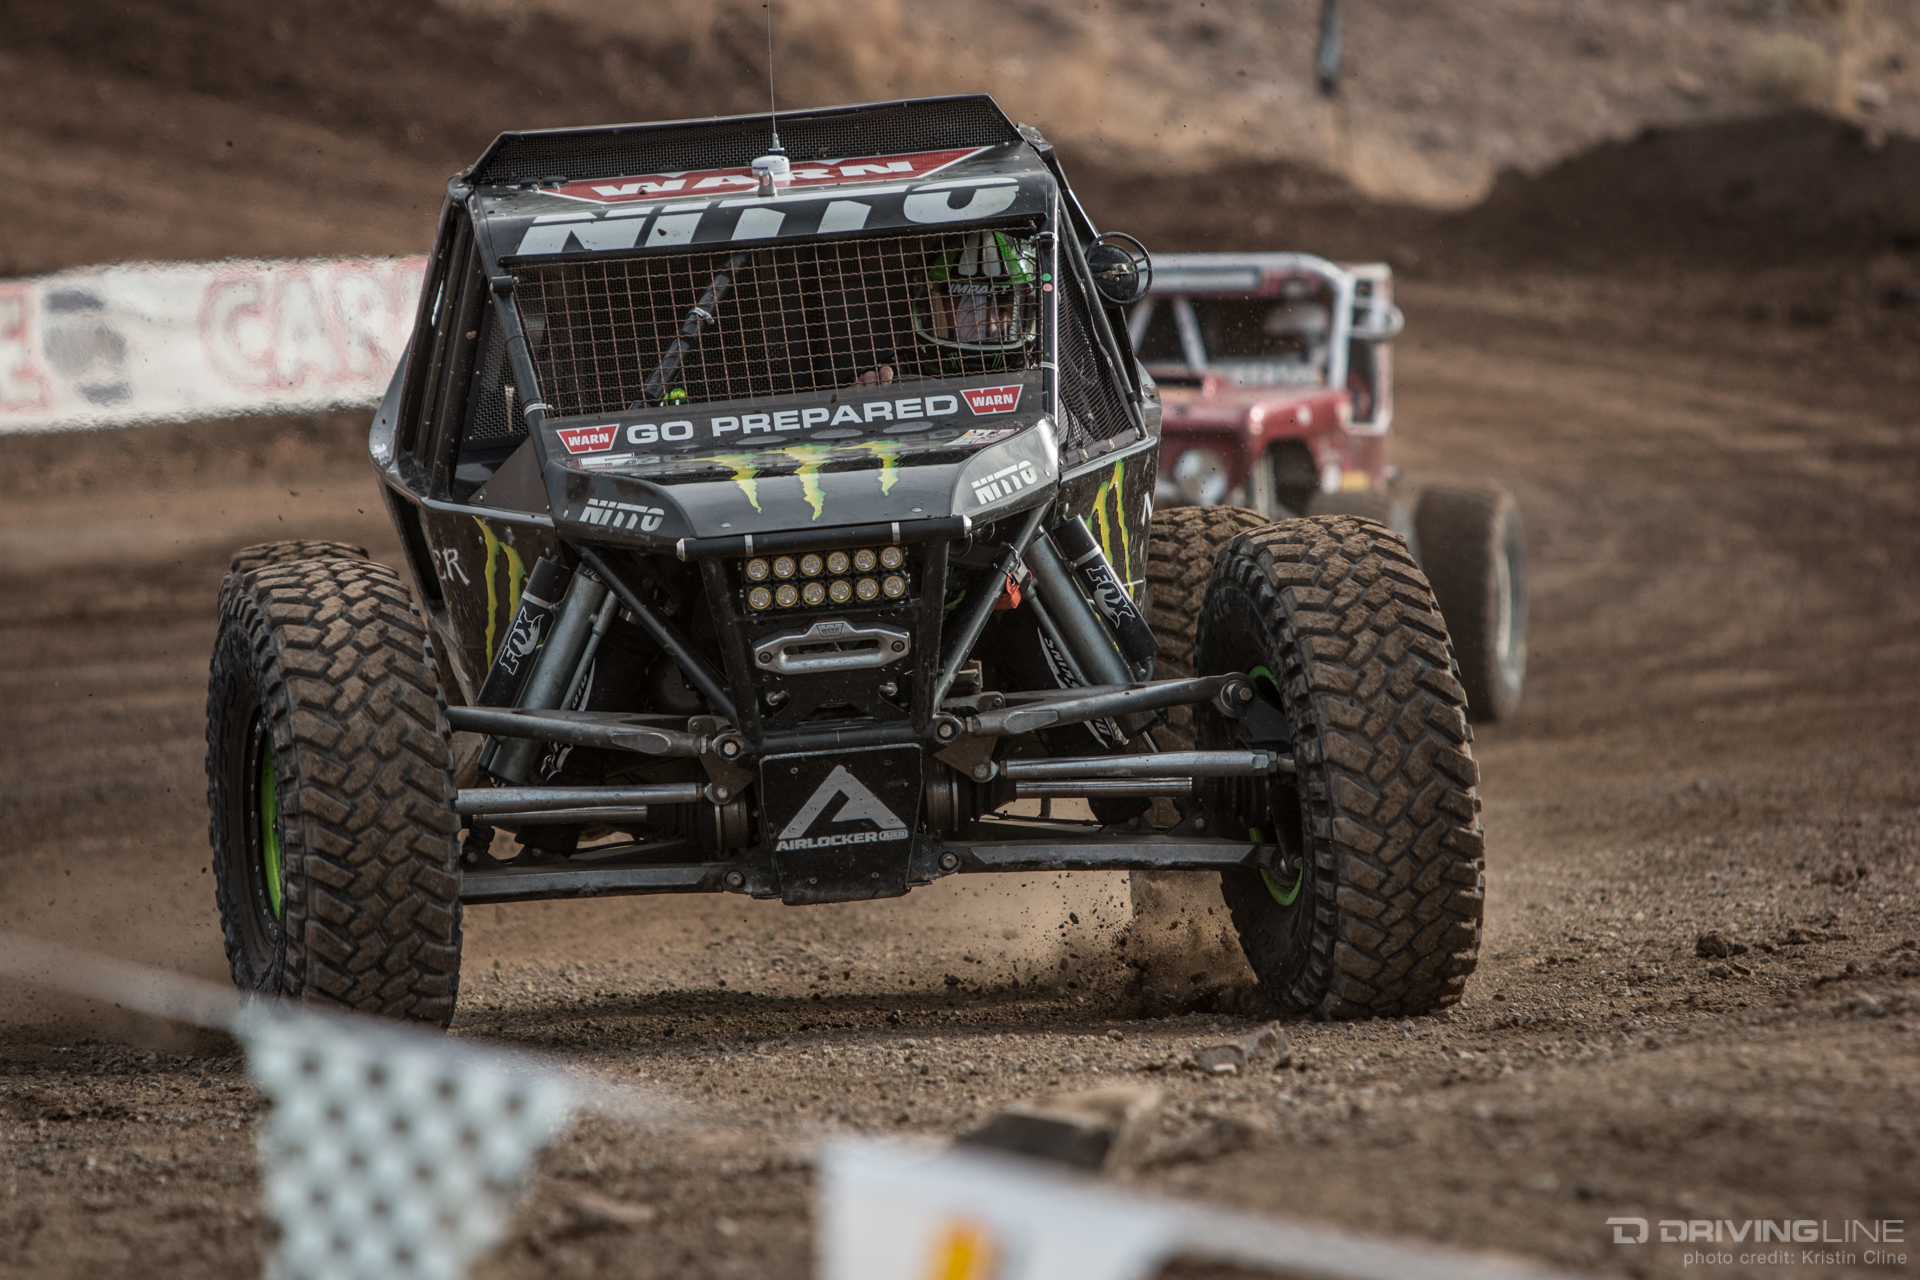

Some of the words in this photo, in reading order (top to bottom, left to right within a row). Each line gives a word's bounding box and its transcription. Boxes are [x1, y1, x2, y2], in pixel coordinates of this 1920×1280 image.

[591, 160, 914, 197] WARN
[515, 177, 1020, 256] NITTO
[948, 283, 1011, 295] IMPACT
[567, 432, 610, 447] WARN
[627, 421, 694, 444] GO
[711, 395, 958, 437] PREPARED
[971, 390, 1014, 407] WARN
[971, 460, 1038, 506] NITTO
[579, 497, 665, 532] NITTO
[1086, 564, 1136, 629] FOX
[499, 605, 545, 675] FOX
[775, 831, 878, 851] AIRLOCKER
